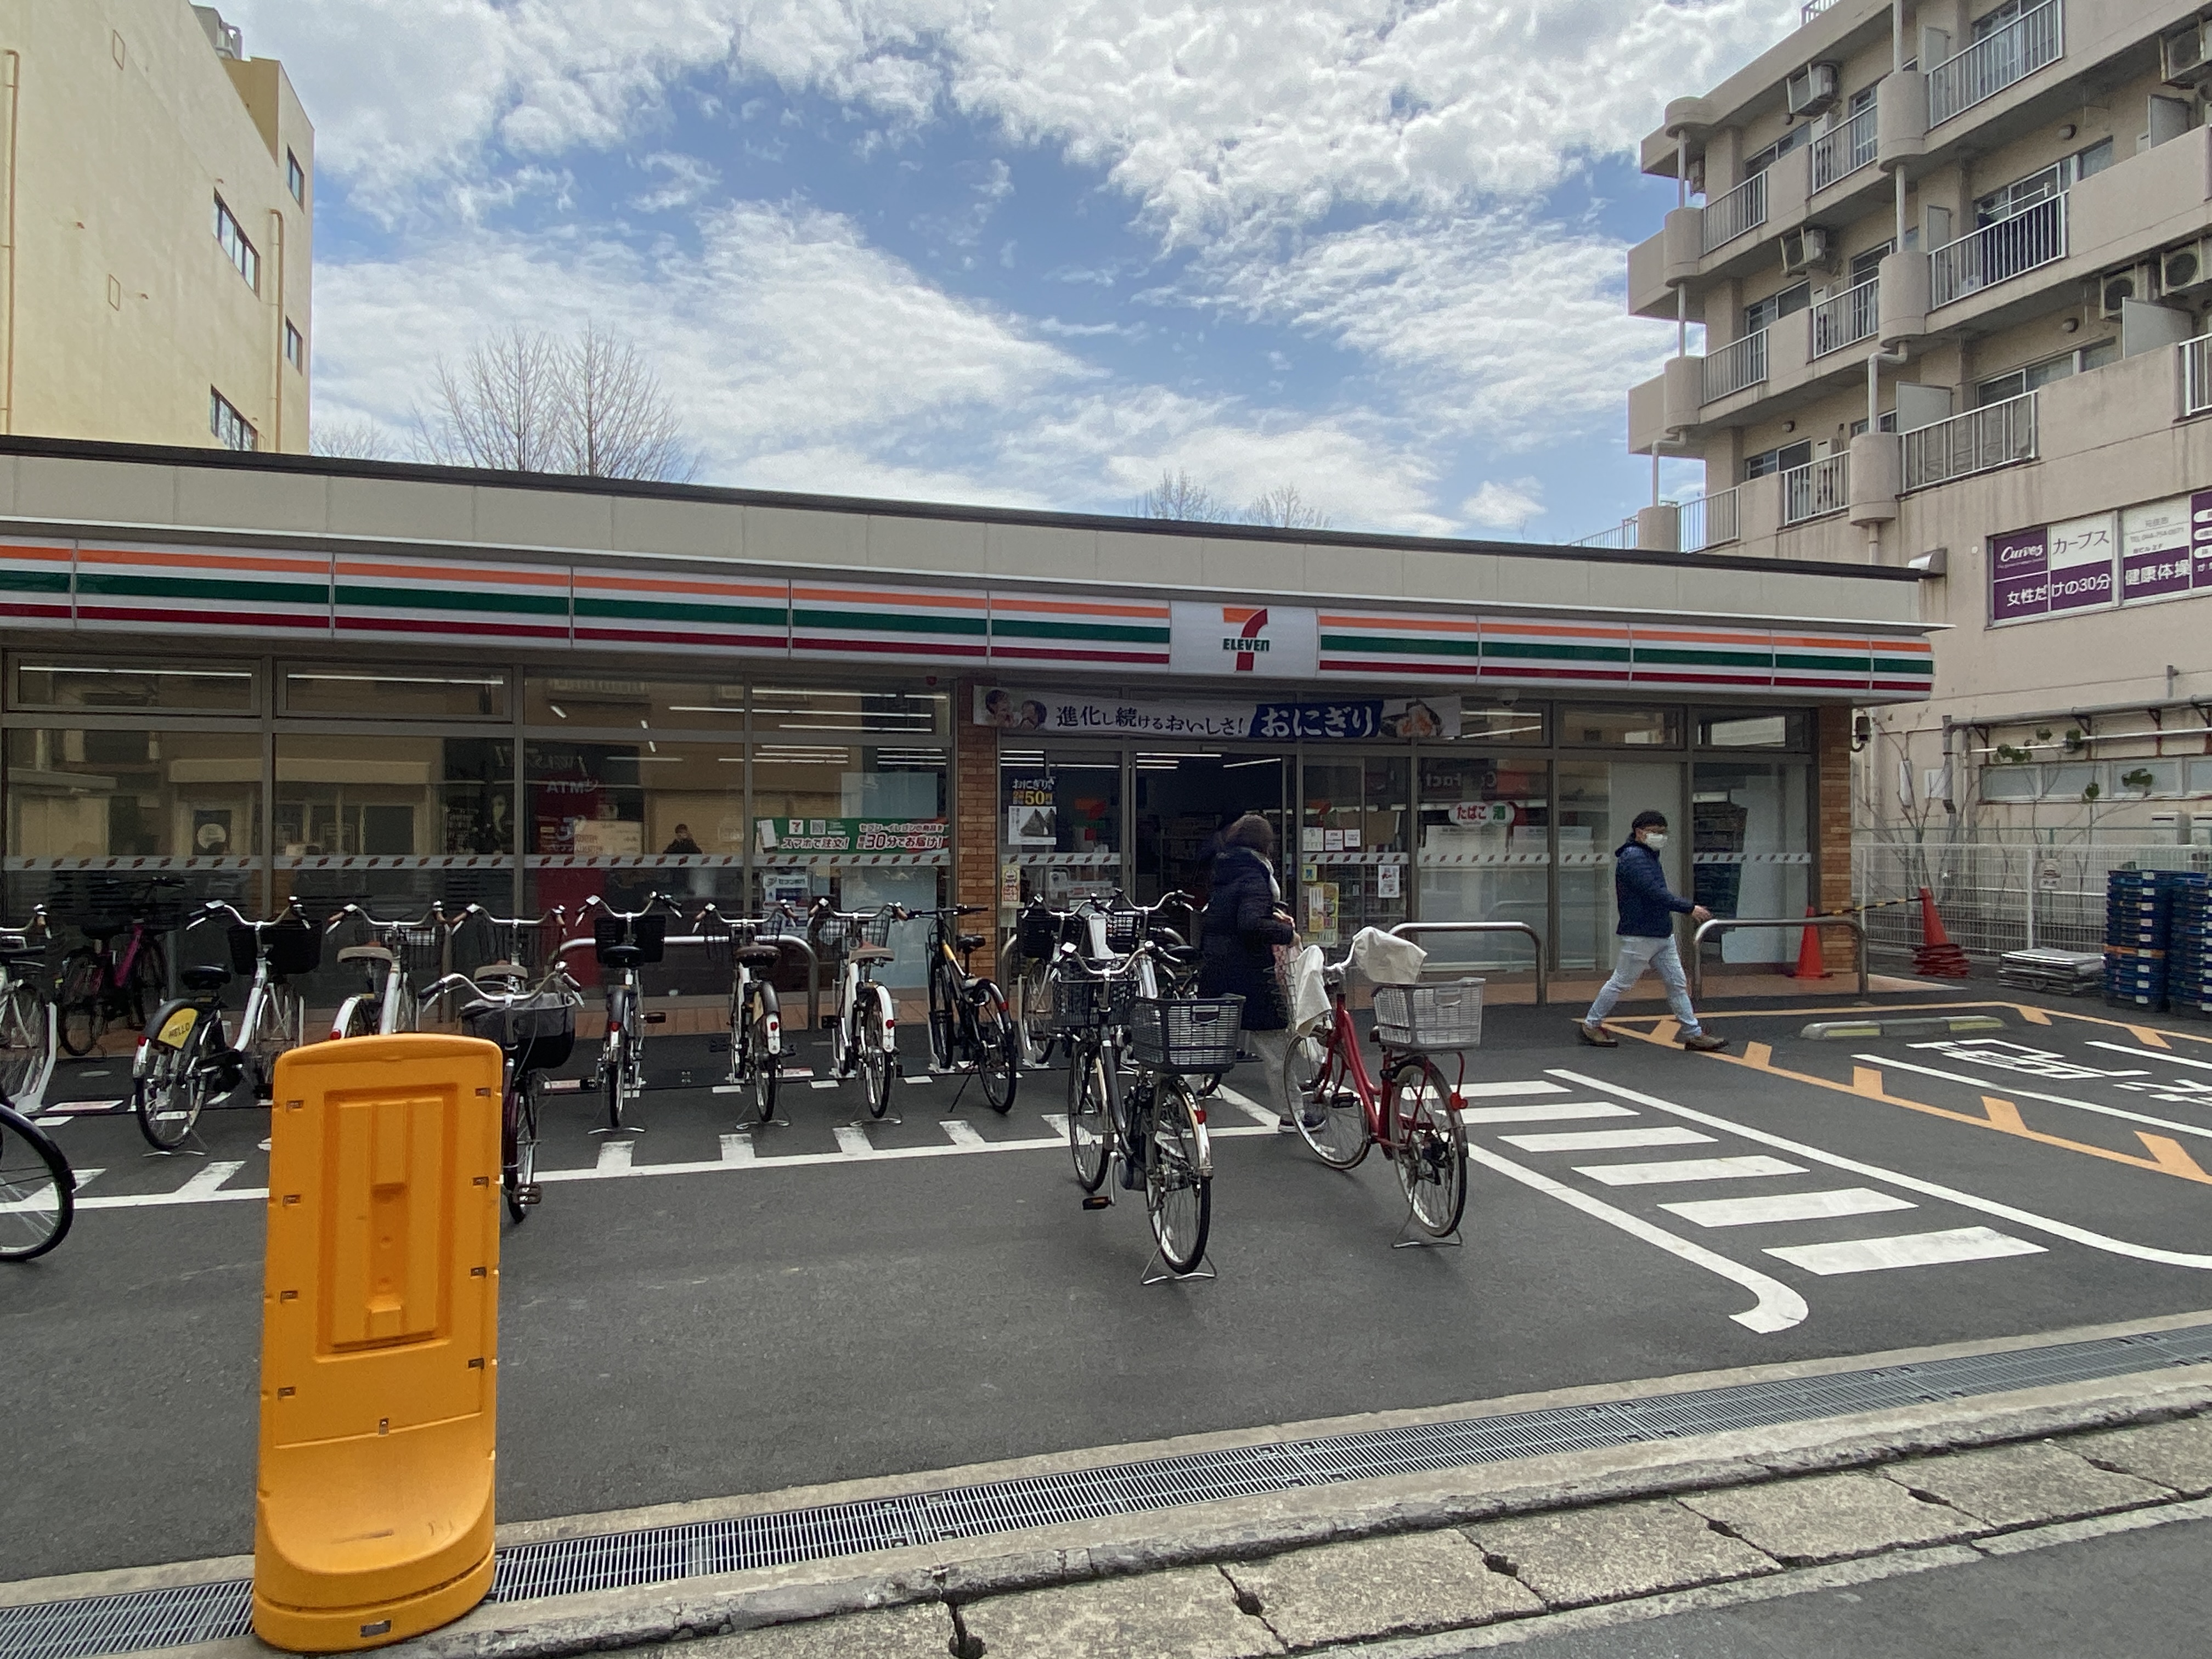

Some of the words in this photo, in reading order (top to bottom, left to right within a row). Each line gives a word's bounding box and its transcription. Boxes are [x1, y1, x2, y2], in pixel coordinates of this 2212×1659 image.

[2000, 544, 2043, 562] Curves
[2006, 573, 2112, 607] 女性だけの30分
[1056, 706, 1244, 736] 進化し続けるおいしさ!
[1261, 706, 1373, 737] おにぎり
[1457, 805, 1487, 820] たばこ
